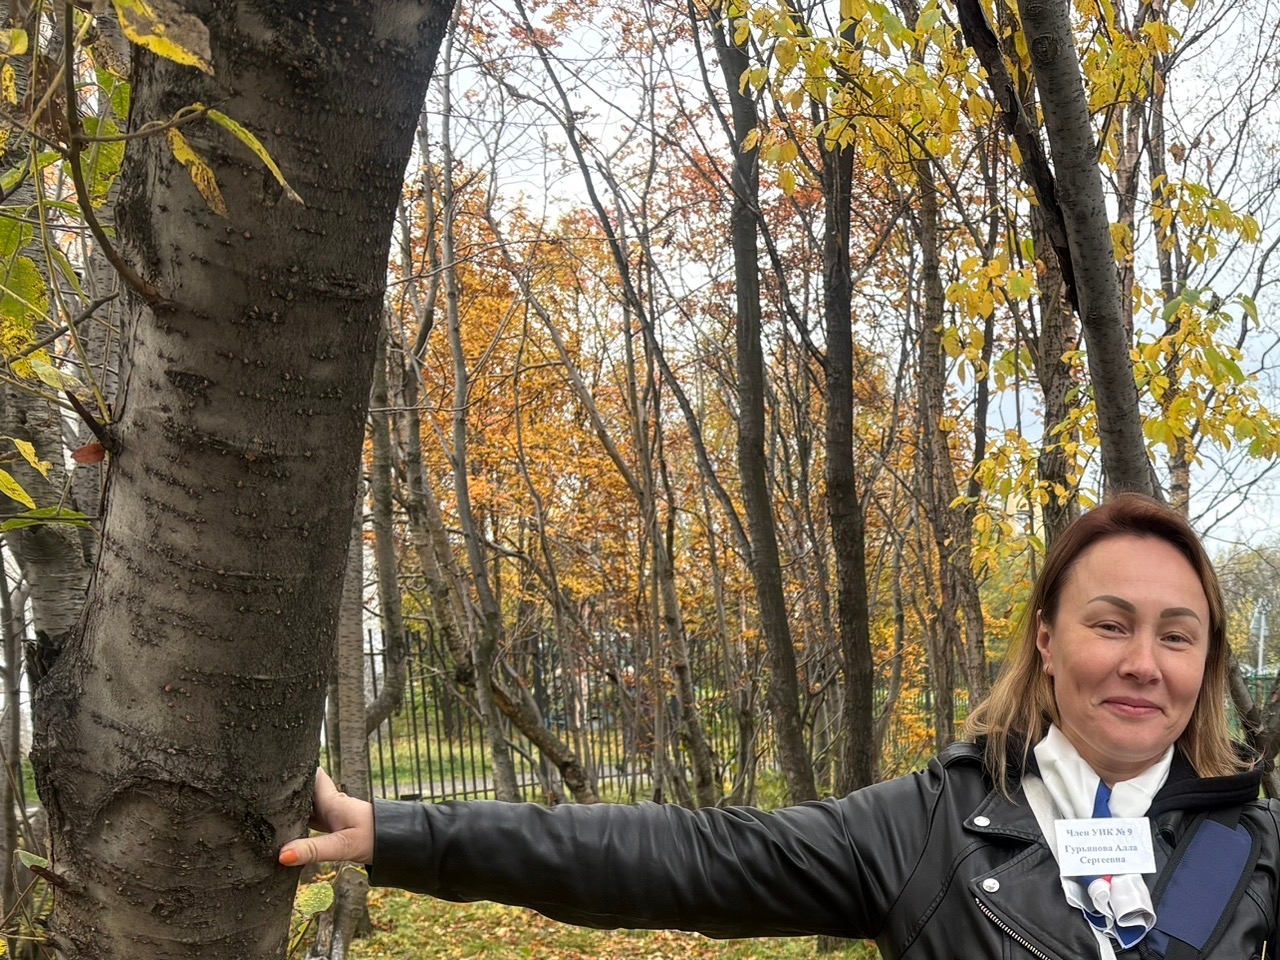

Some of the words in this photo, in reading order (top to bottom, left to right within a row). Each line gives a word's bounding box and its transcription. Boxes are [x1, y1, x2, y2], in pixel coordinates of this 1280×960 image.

[1066, 828, 1090, 837] Член
[1092, 828, 1113, 837] УИК
[1115, 828, 1126, 836] №
[1127, 828, 1133, 836] 9
[1064, 845, 1113, 854] Гурьянова
[1115, 844, 1138, 852] Алла
[1079, 856, 1126, 865] Сергеевна
